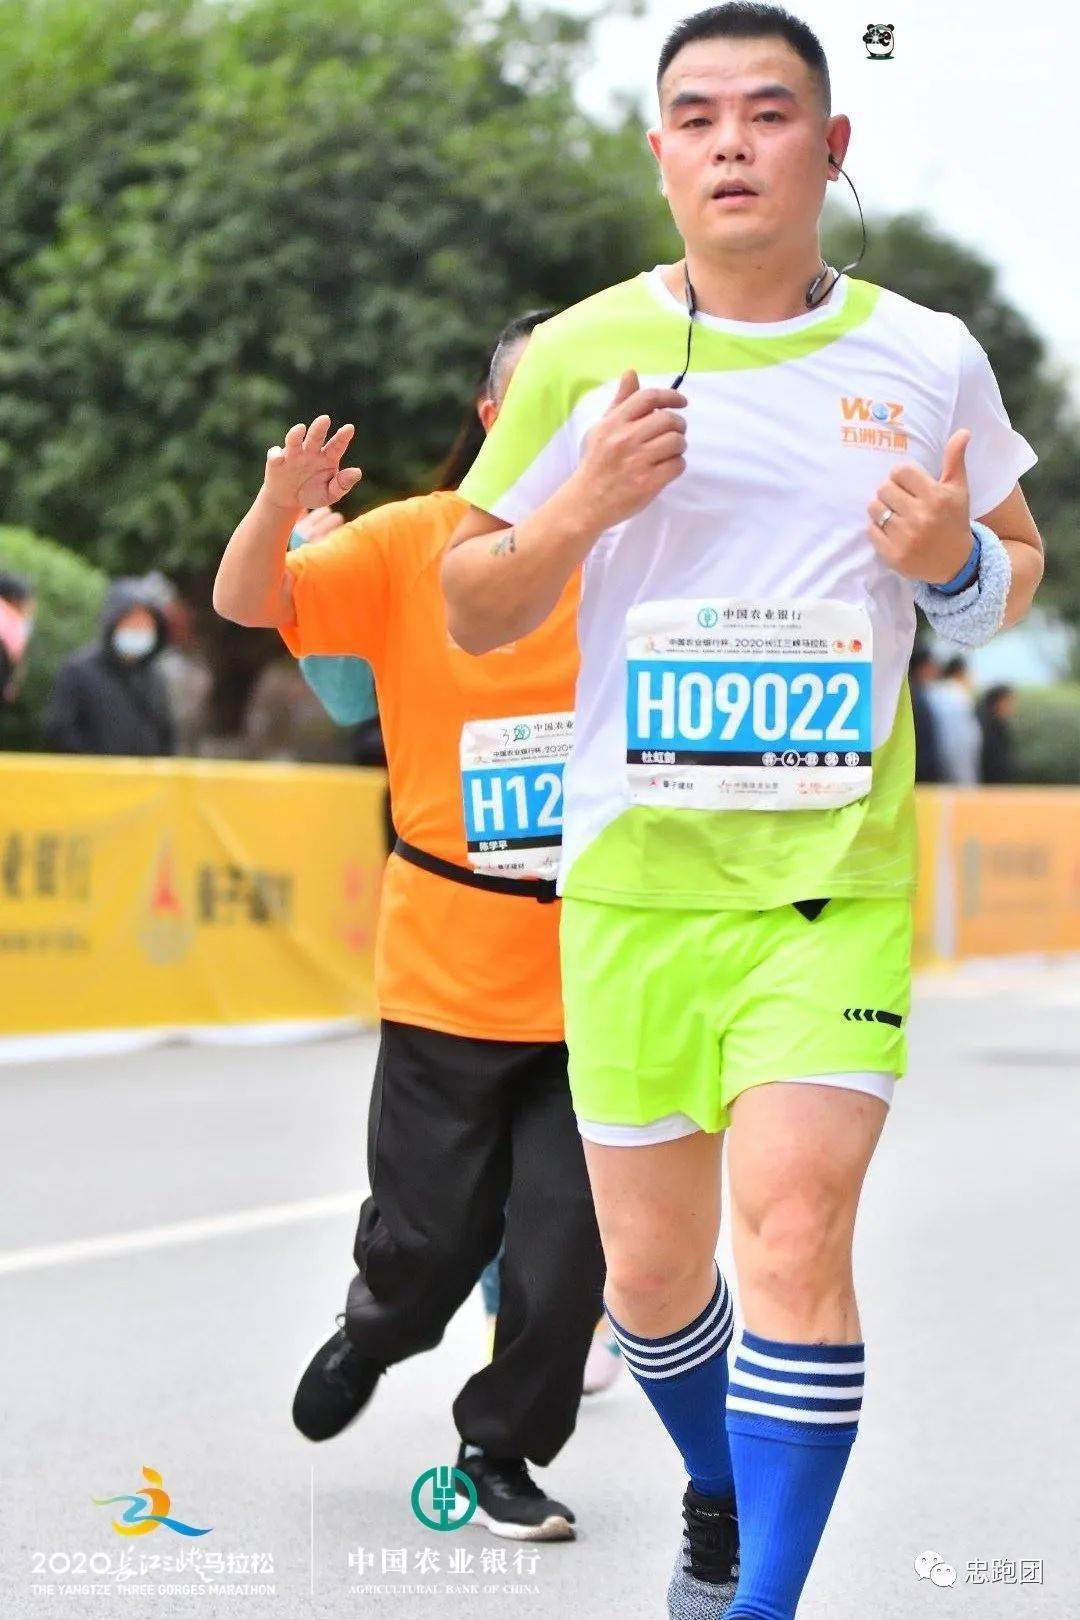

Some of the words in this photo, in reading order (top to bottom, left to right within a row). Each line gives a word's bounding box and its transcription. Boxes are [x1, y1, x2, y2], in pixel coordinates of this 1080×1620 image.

[723, 608, 802, 621] 中国农业银行
[637, 671, 860, 741] H09022
